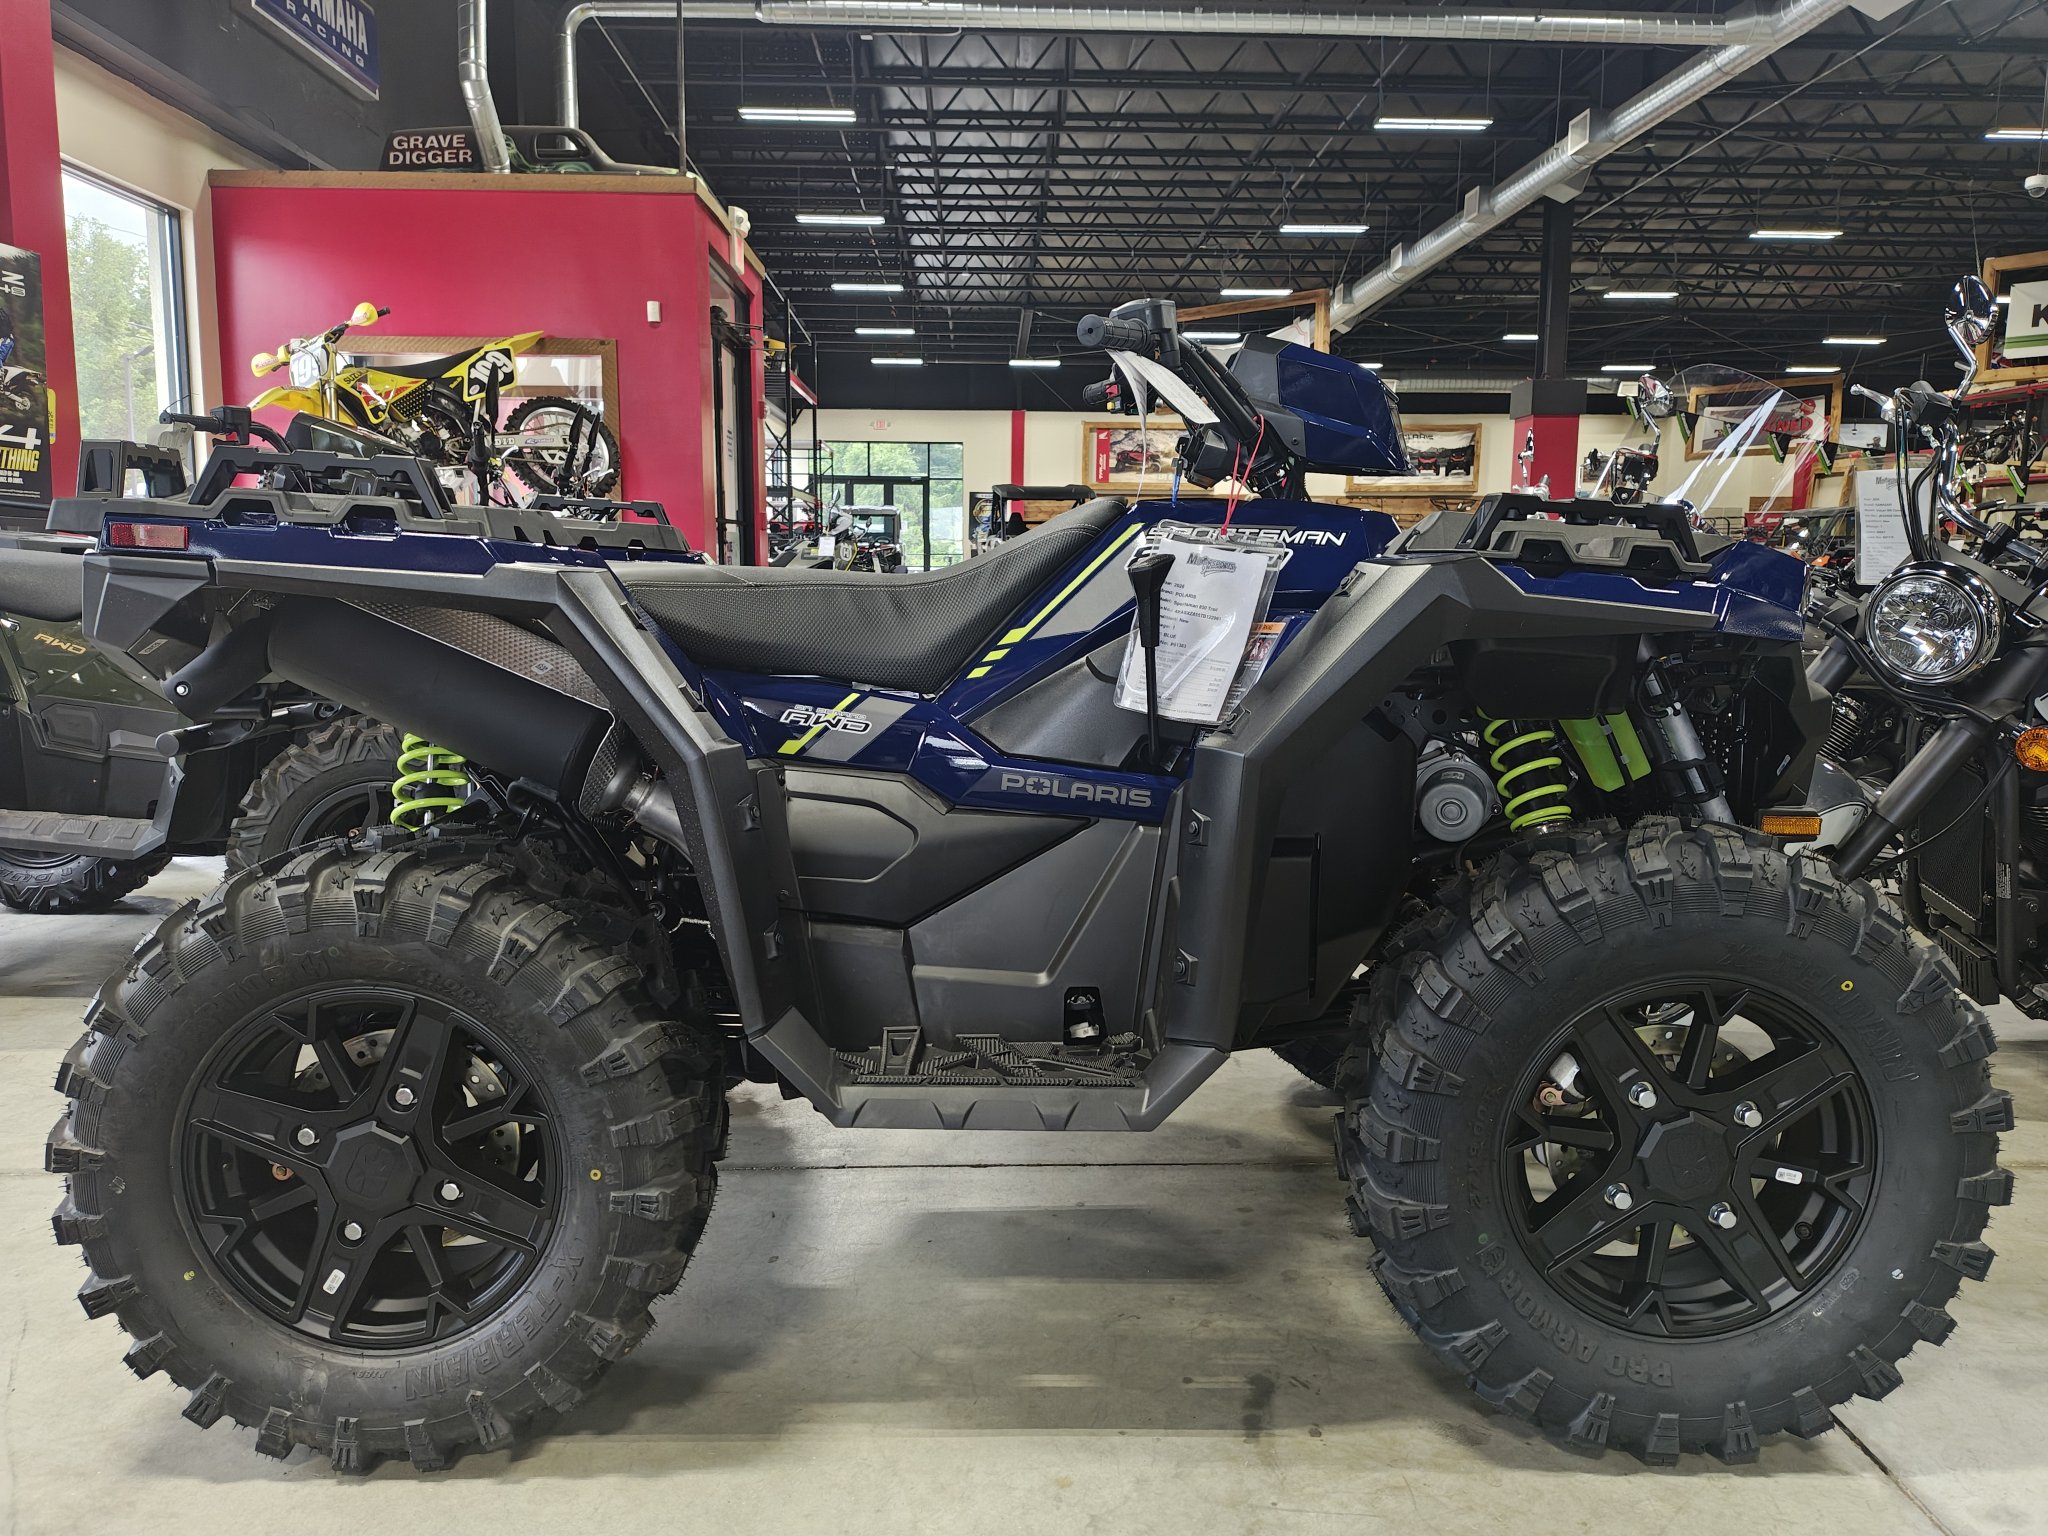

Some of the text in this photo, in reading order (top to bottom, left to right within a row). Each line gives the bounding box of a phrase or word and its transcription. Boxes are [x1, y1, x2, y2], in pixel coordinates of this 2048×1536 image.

[286, 0, 365, 67] RACING
[303, 0, 368, 55] MAHA
[389, 149, 473, 165] DIGGER
[392, 134, 466, 150] GRAVE
[0, 446, 40, 472] THING
[34, 632, 87, 655] AWD
[779, 708, 872, 735] AWD
[1000, 772, 1153, 808] POLARIS
[404, 1254, 585, 1402] X-TERRAIN
[1500, 1268, 1674, 1388] PRO ARMOR
